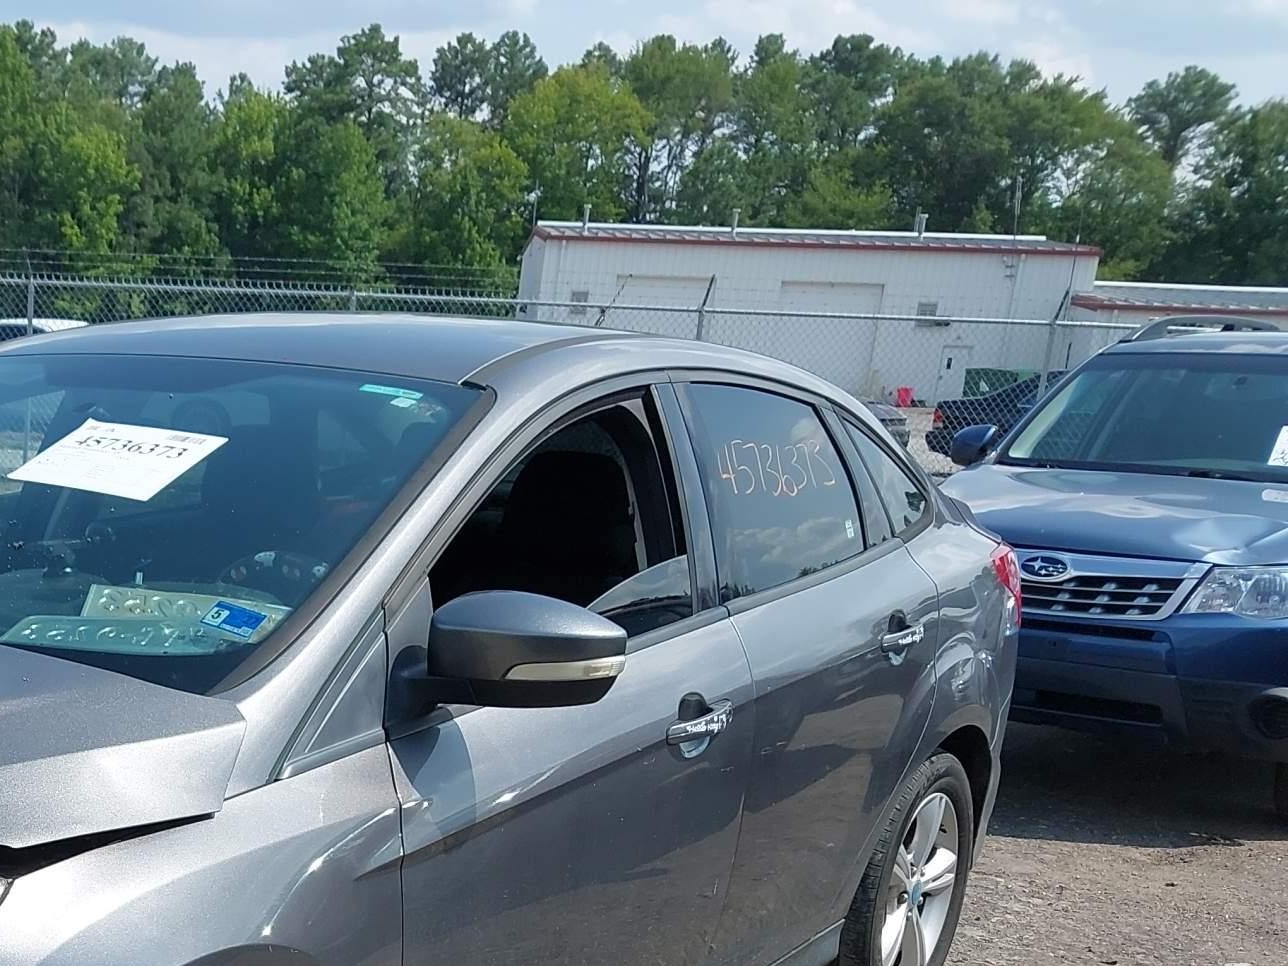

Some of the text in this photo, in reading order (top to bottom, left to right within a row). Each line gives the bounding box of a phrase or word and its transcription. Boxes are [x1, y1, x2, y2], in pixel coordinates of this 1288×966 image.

[74, 435, 188, 459] 45736373
[717, 439, 835, 496] 45736373
[211, 609, 225, 620] 5
